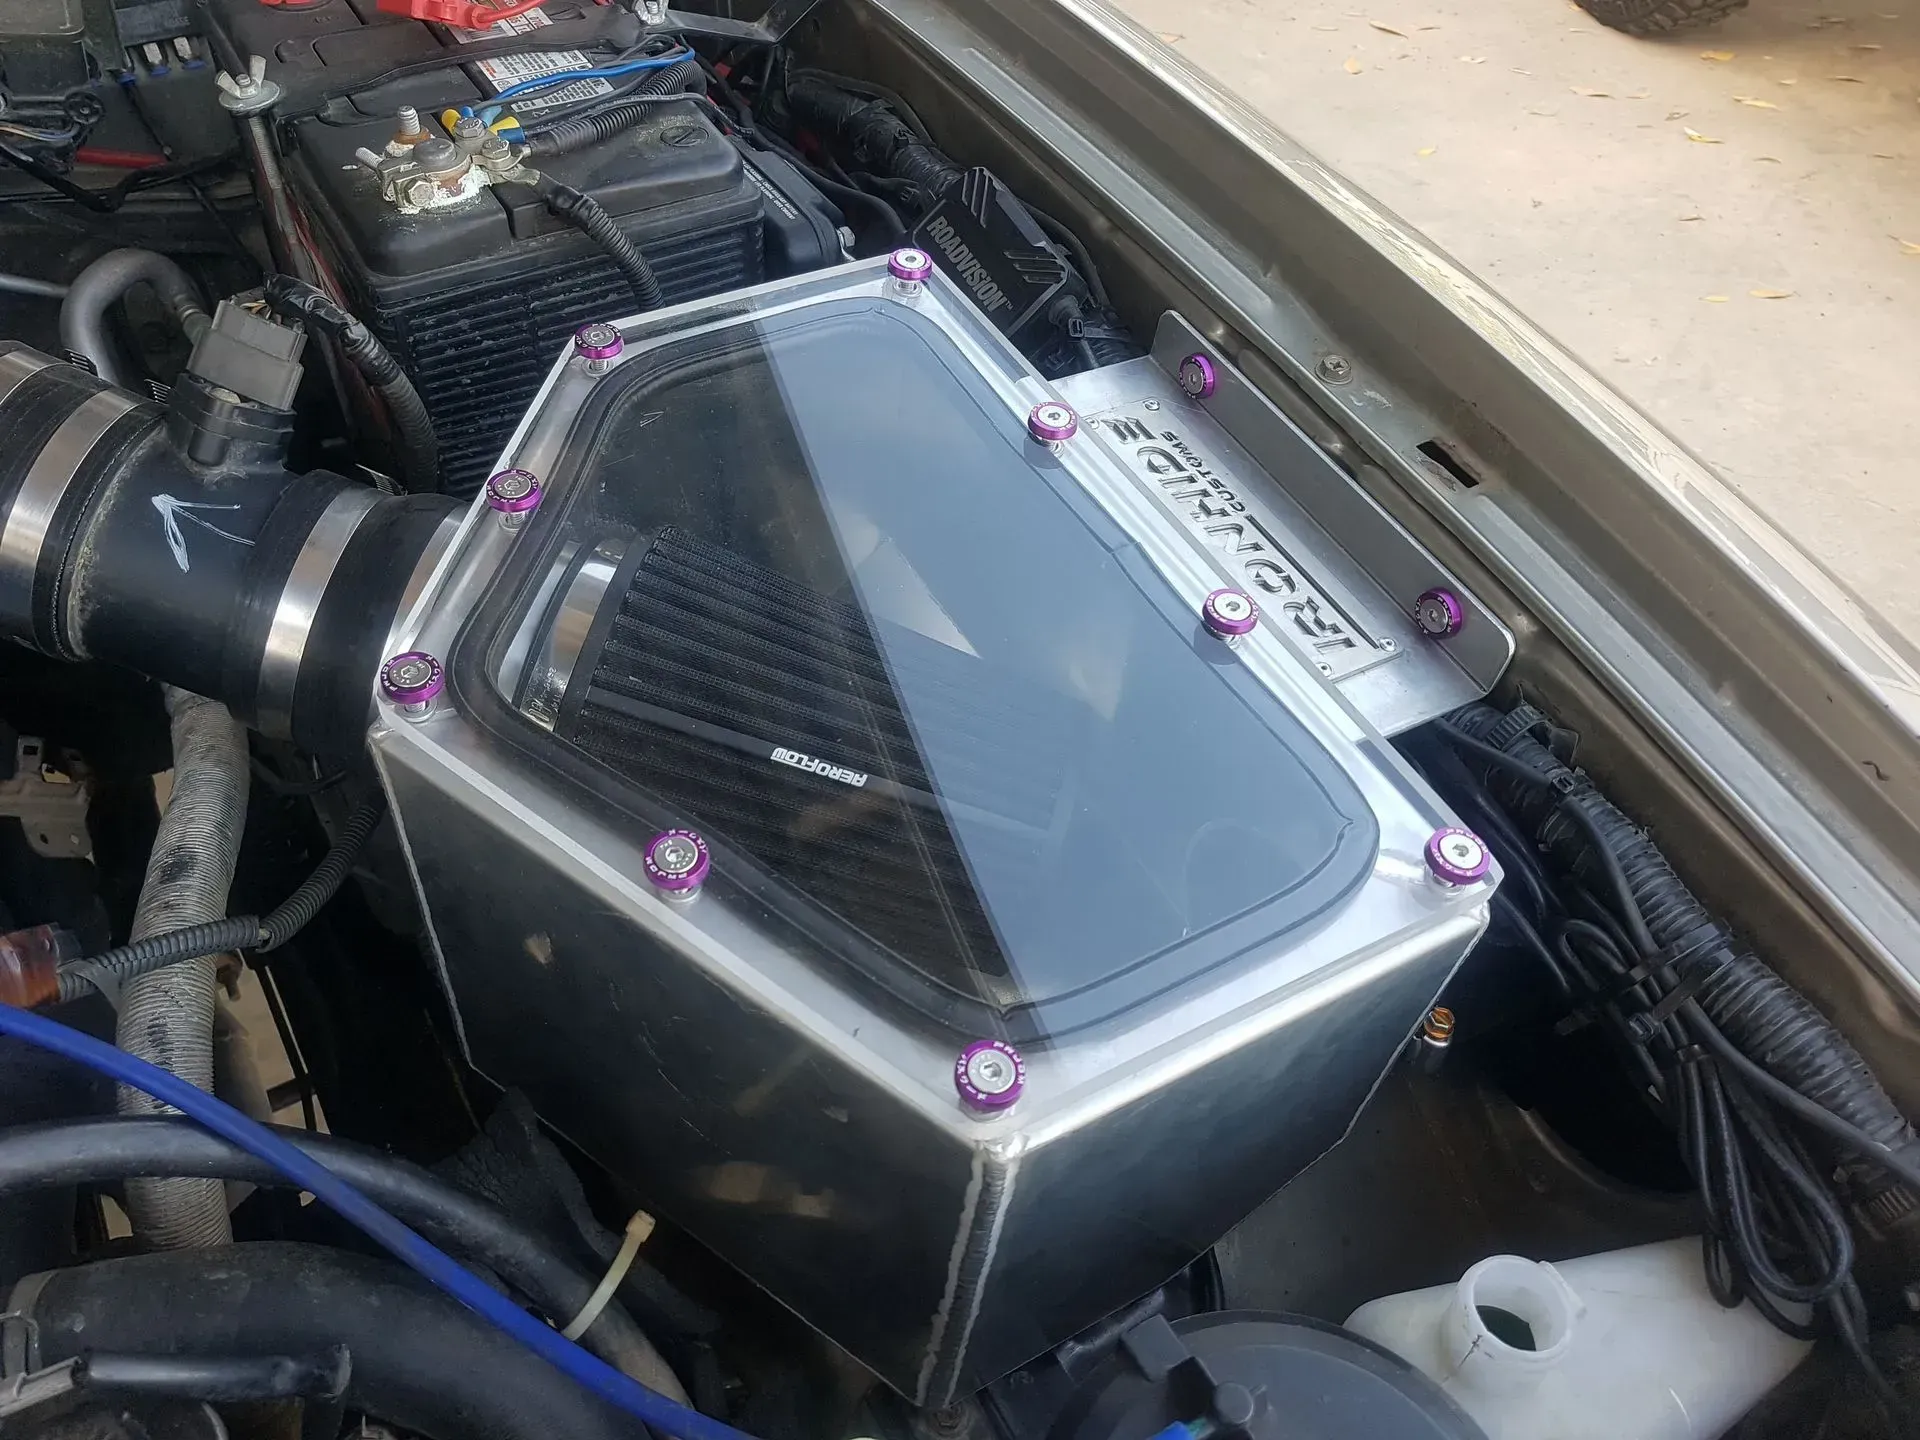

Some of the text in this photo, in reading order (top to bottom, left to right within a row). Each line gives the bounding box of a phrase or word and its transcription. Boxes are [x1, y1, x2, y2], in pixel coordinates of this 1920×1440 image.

[1160, 431, 1247, 514] CUSTOMS
[1102, 415, 1358, 654] IRONHIDE
[770, 747, 868, 788] AEROFLOW
